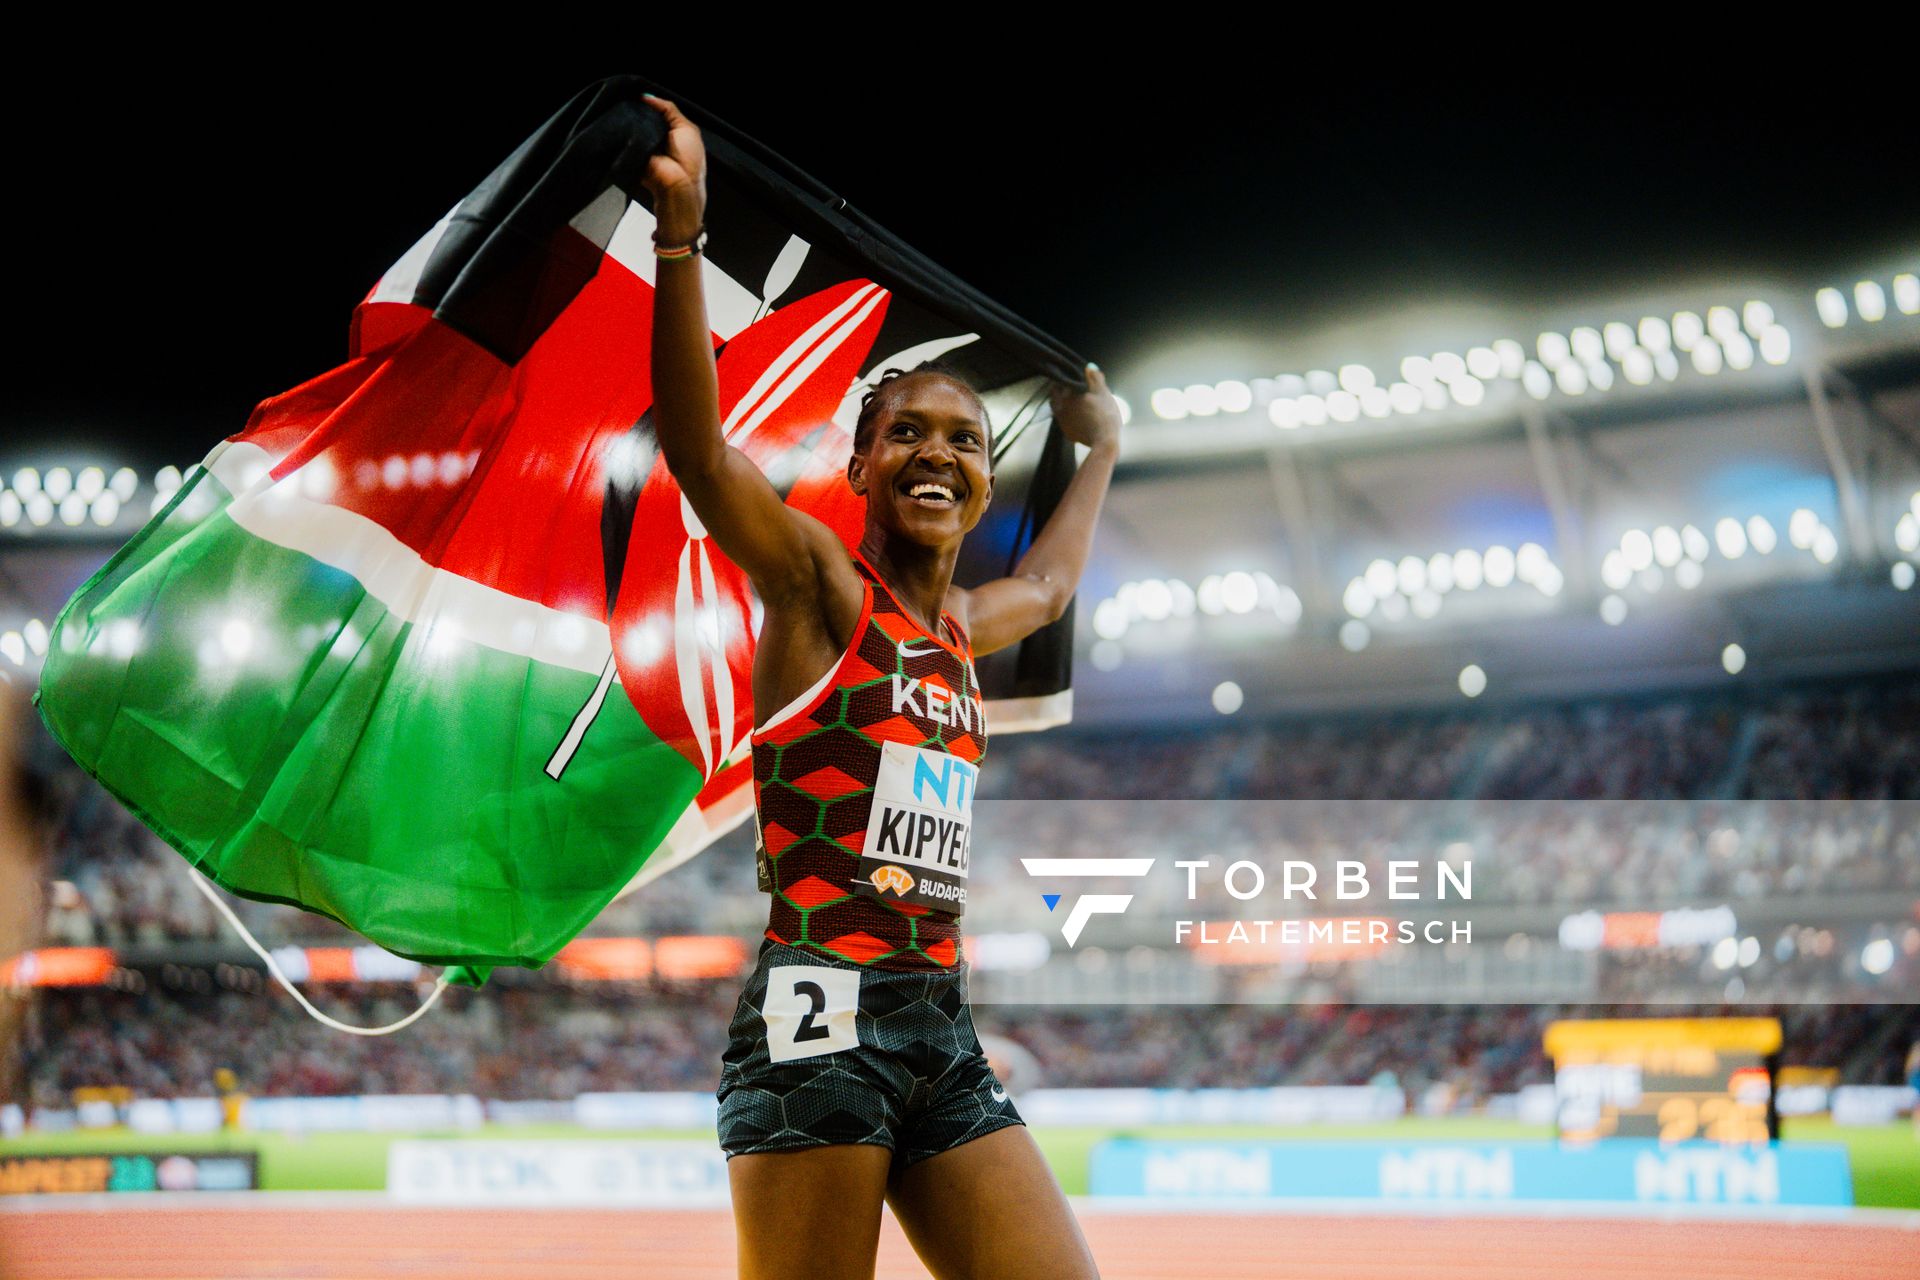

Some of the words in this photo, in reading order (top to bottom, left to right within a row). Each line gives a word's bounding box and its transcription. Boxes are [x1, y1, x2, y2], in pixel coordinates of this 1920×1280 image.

[892, 673, 987, 738] KENY
[913, 751, 978, 813] NT
[793, 980, 830, 1044] 2
